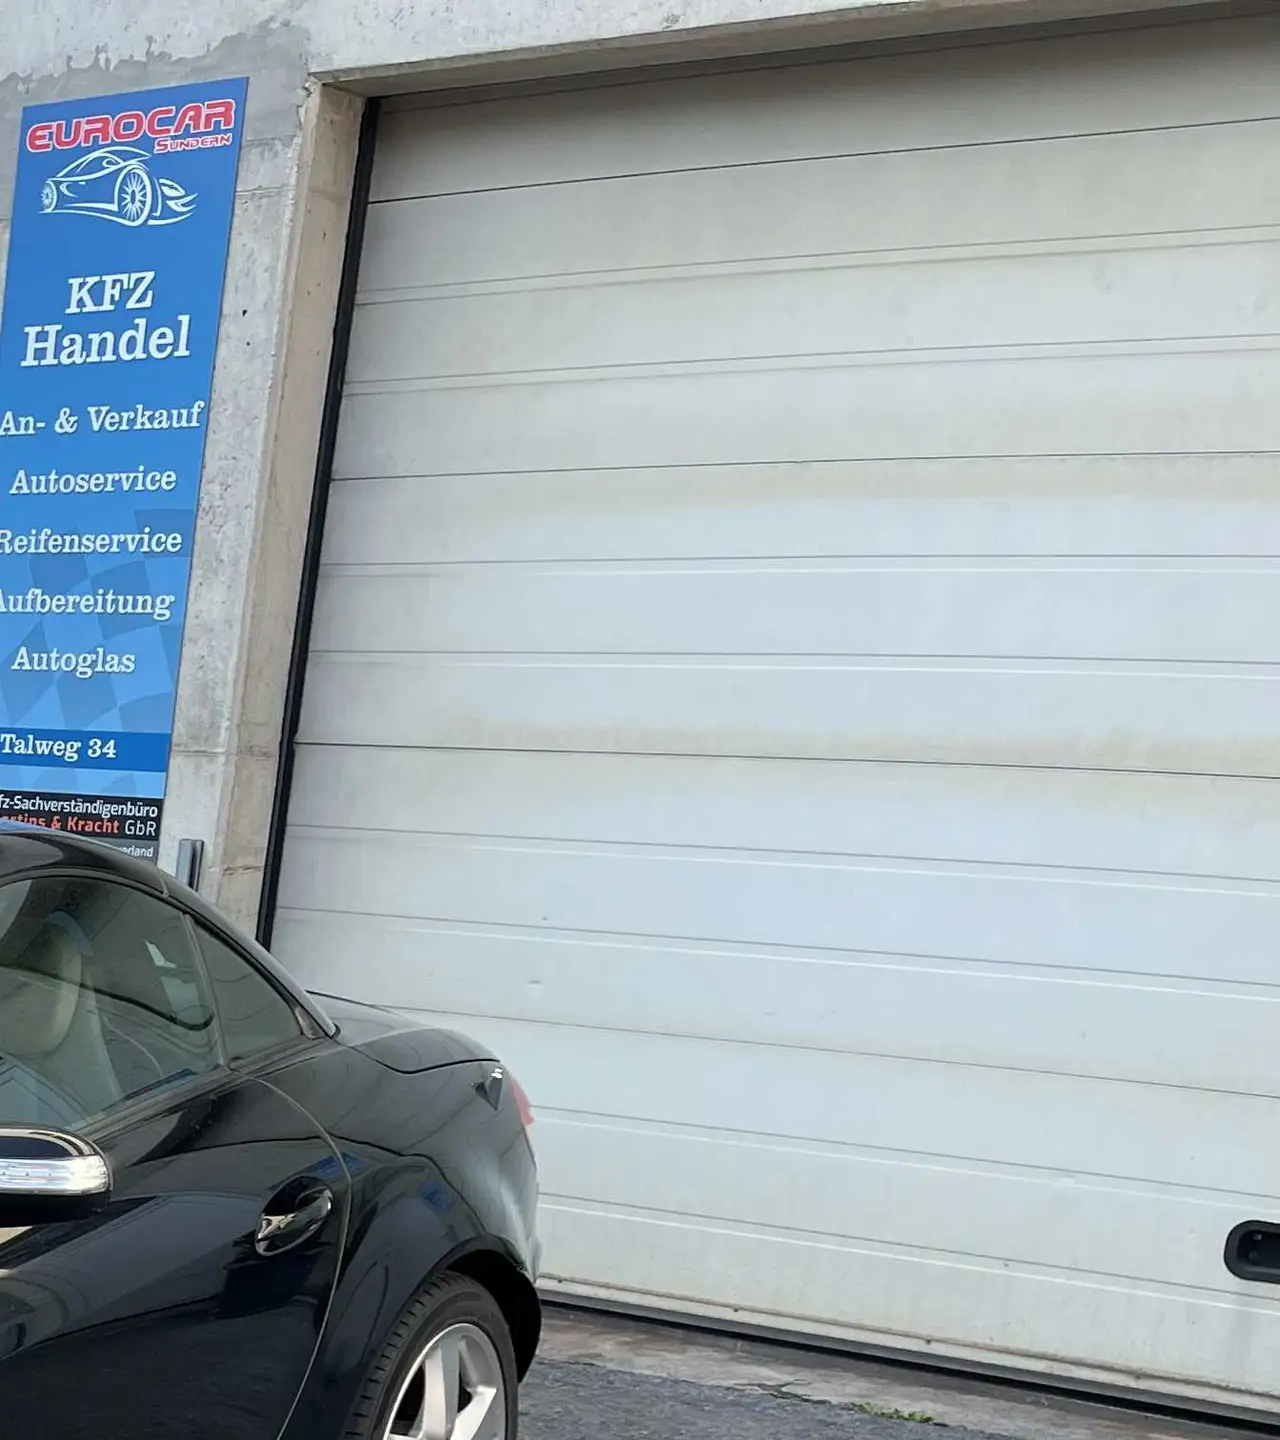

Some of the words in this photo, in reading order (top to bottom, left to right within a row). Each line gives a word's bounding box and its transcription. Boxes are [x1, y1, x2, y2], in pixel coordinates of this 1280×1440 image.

[26, 98, 236, 153] EUROCAR
[65, 271, 155, 315] KFZ
[20, 315, 190, 367] Handel
[56, 407, 78, 434] &
[87, 400, 207, 432] Verkauf
[9, 466, 177, 495] Autoservice
[10, 647, 136, 679] Autoglas
[0, 733, 82, 762] Talweg
[87, 737, 117, 760] 34
[51, 815, 62, 830] &
[67, 816, 120, 834] Kracht
[125, 820, 157, 836] GbR
